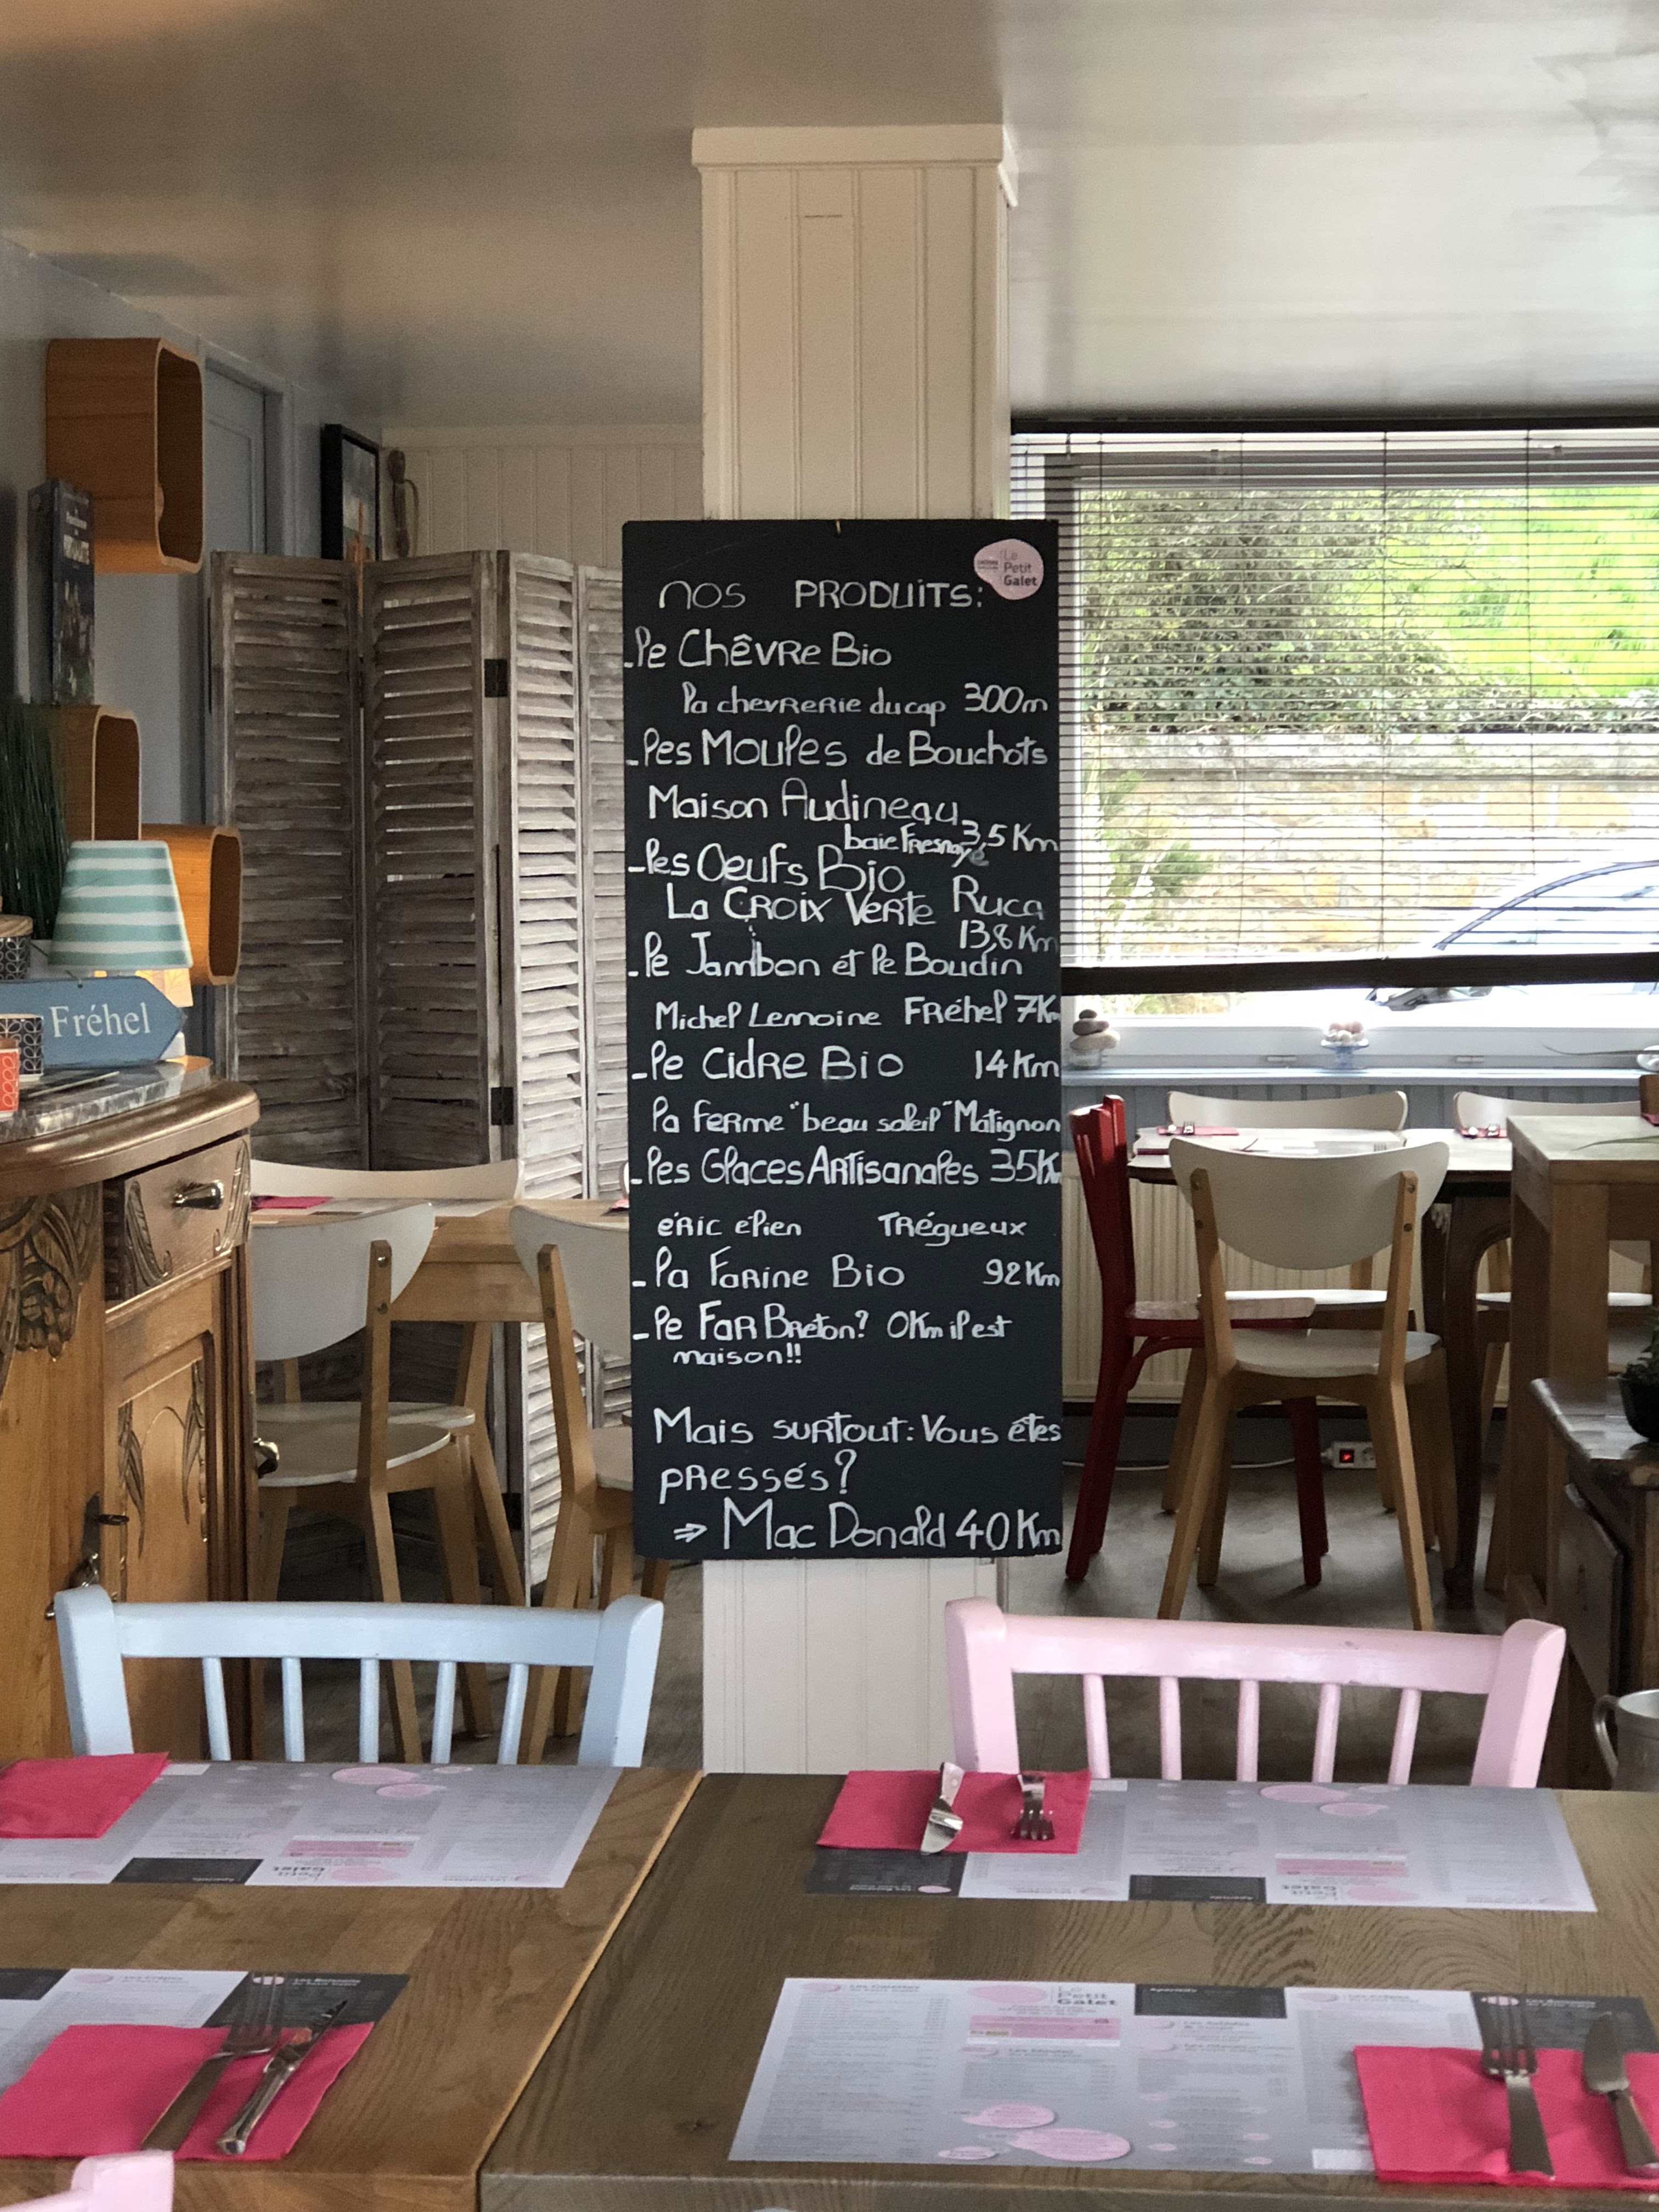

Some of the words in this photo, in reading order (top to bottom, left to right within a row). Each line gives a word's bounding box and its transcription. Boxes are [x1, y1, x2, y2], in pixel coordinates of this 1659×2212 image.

[1003, 562, 1032, 573] Petit
[1003, 574, 1037, 586] Galet
[832, 631, 891, 667] Bio
[716, 685, 861, 714] chevrerie
[701, 724, 848, 767] Moules
[866, 733, 902, 765] de
[909, 729, 1048, 767] Bouchots
[648, 784, 768, 820] Maison
[781, 777, 958, 828] Audineau
[844, 823, 900, 851] baie
[817, 843, 906, 895] Bio
[666, 882, 709, 921] La
[723, 885, 834, 923] Croix
[844, 890, 936, 927] Verte
[685, 930, 821, 977] Jambon
[832, 949, 865, 977] et
[871, 943, 898, 975] le
[904, 941, 1024, 977] Boudin
[49, 1002, 151, 1038] Fréhel
[655, 1000, 742, 1031] Michel
[748, 1002, 882, 1028] Lemoine
[904, 989, 1008, 1025] Fréhel
[702, 1037, 808, 1080] Cidre
[821, 1045, 904, 1081] Bio
[693, 1099, 785, 1134] ferme
[954, 1099, 1062, 1142] Matignon
[701, 1147, 805, 1186] Glaces
[806, 1145, 979, 1186] Artisanales
[709, 1245, 809, 1289] Farine
[831, 1253, 905, 1288] Bio
[698, 1300, 758, 1341] Far
[653, 1406, 754, 1445] Mais
[921, 1414, 999, 1444] Vous
[1007, 1413, 1062, 1443] êtes
[828, 1501, 946, 1549] Donald
